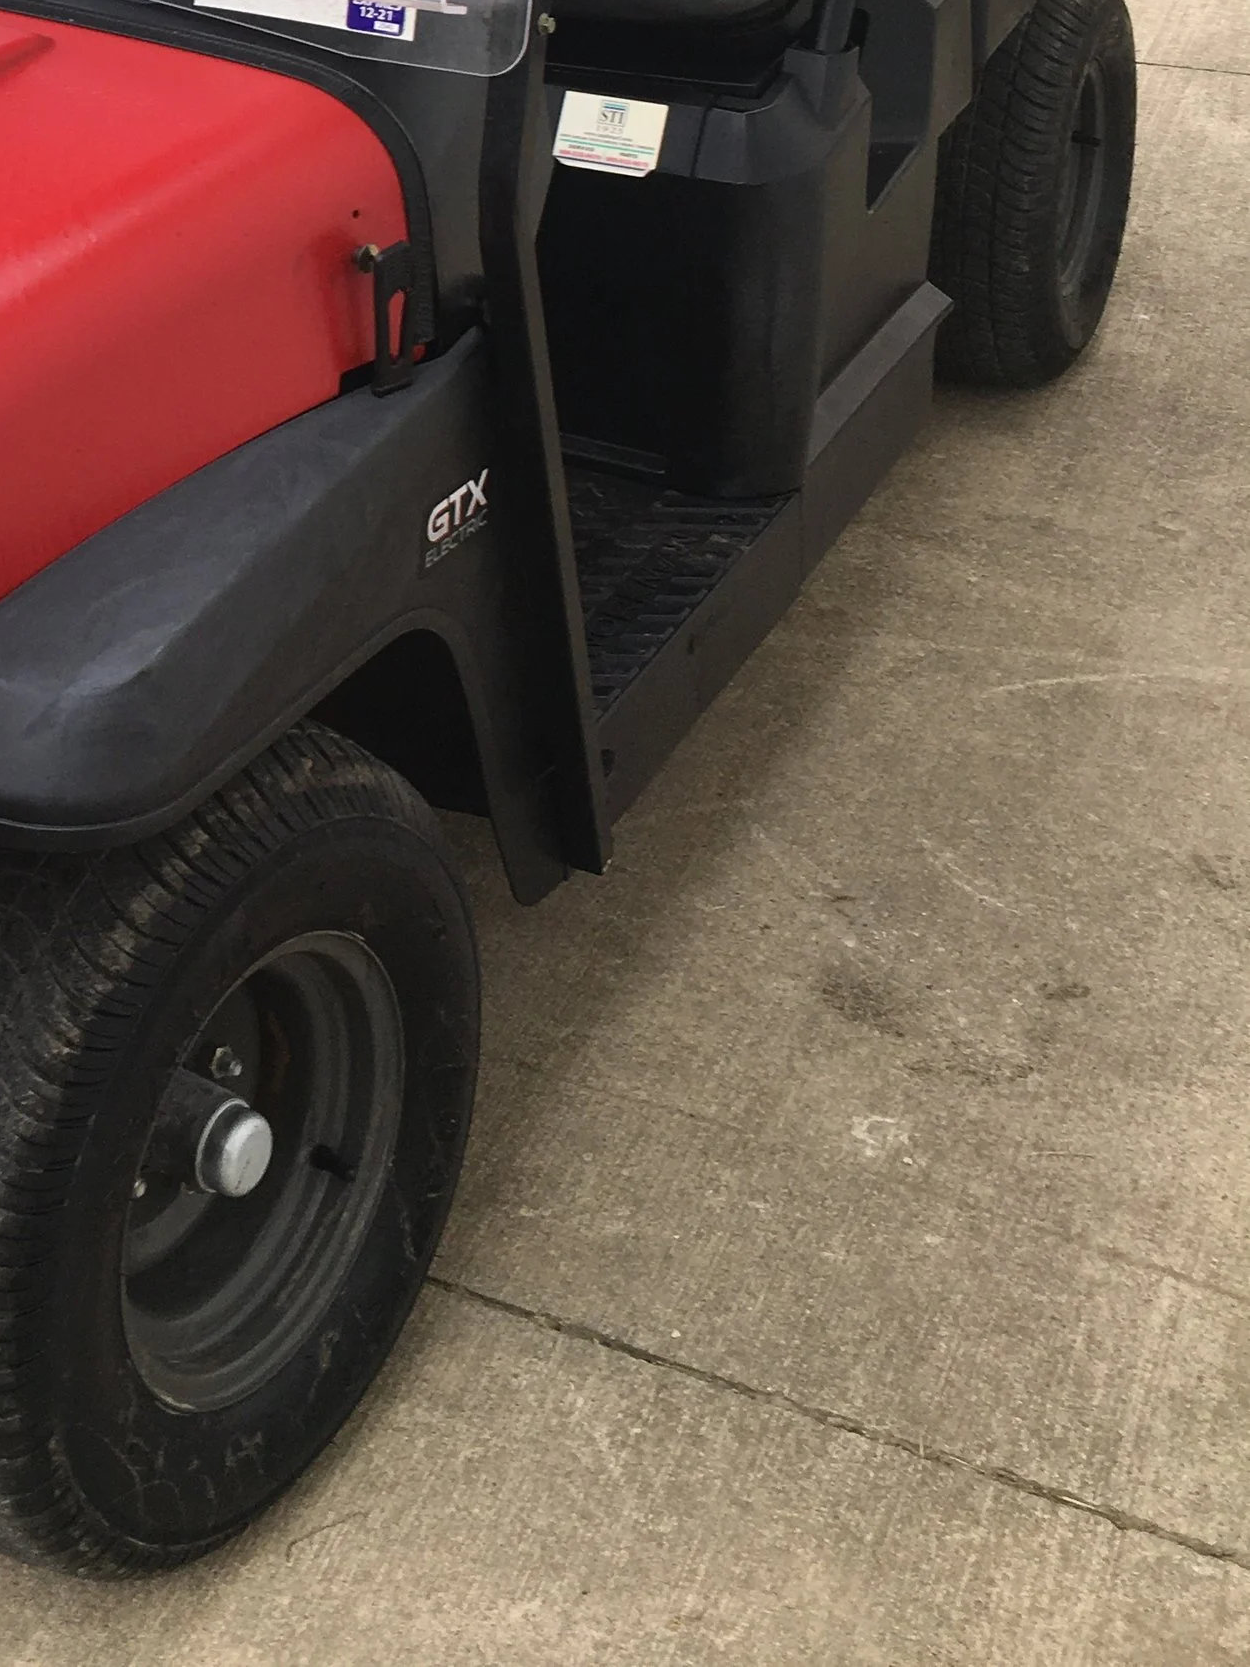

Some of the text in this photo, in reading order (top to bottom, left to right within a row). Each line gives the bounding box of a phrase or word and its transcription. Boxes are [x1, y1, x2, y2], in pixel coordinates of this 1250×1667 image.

[359, 6, 393, 21] 12-21
[599, 110, 624, 124] STI
[427, 468, 489, 542] GTX
[424, 508, 488, 568] ELECTRIC
